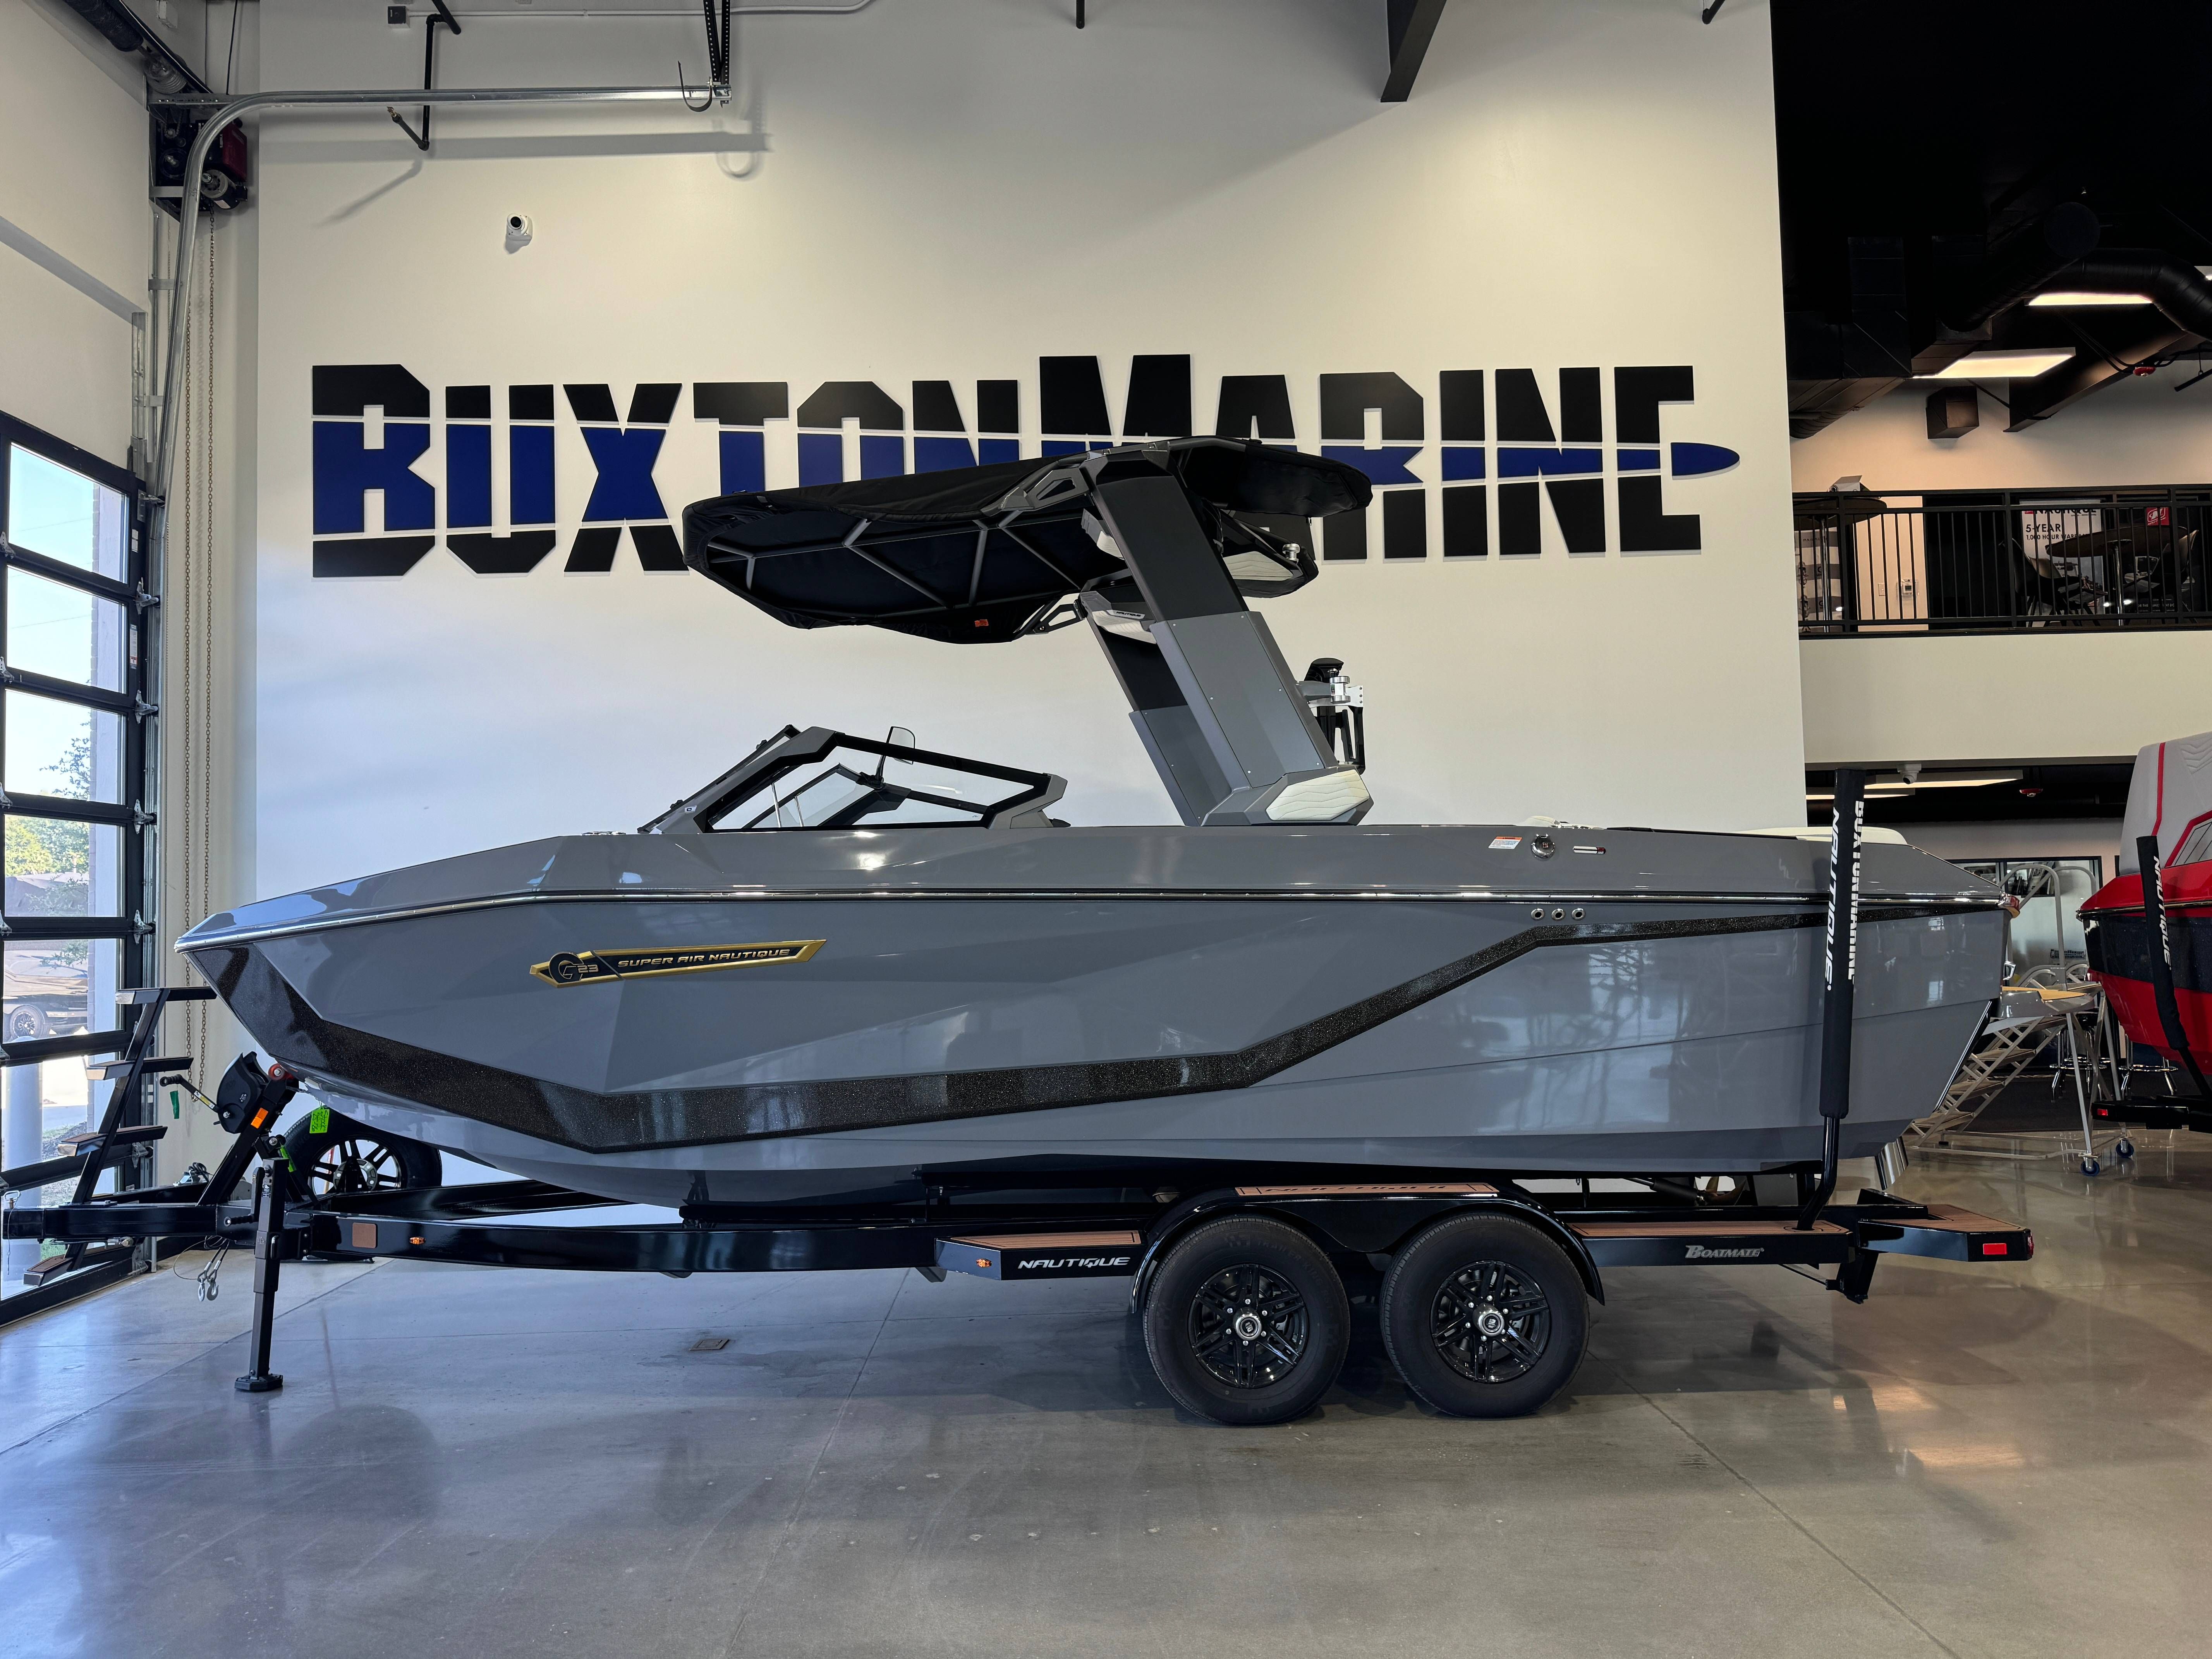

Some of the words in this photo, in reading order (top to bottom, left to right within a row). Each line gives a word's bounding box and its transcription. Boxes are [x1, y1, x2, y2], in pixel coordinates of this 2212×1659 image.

[1825, 806, 1839, 986] NAUTIQUE
[2154, 855, 2171, 967] NAUTIQUE
[618, 957, 673, 967] SUPER
[677, 955, 704, 963] AIR
[708, 948, 790, 961] NAUTIQUE
[1685, 1245, 1762, 1258] BOATMATE
[1017, 1257, 1131, 1268] NAUTIQUE
